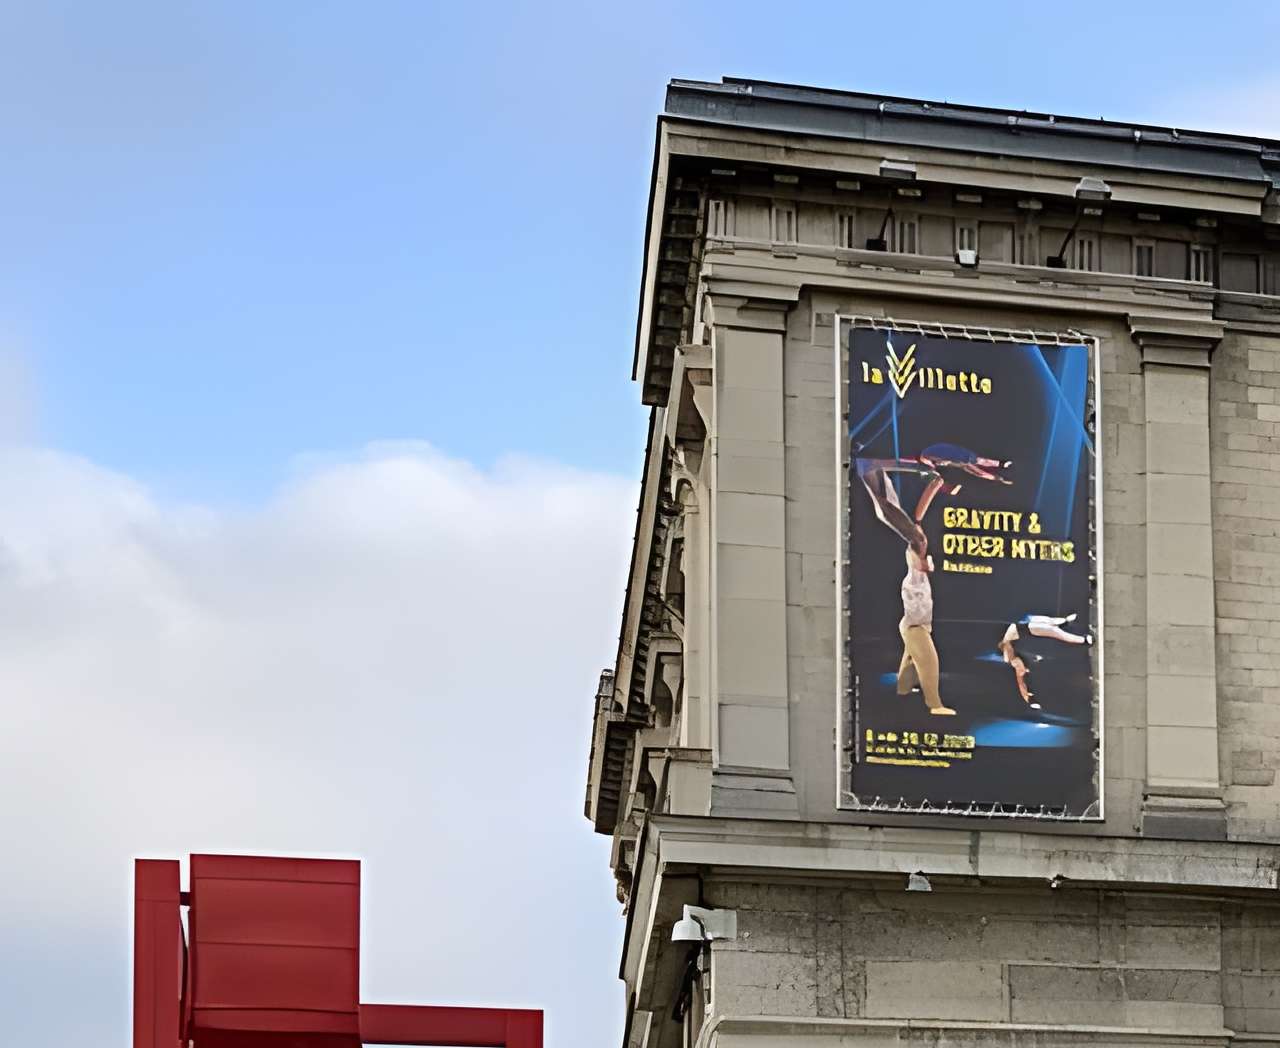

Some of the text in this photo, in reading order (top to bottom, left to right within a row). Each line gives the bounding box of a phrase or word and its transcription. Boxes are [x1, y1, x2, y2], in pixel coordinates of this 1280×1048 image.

[943, 506, 1042, 534] GRAVITY &
[942, 533, 1005, 558] OTHER
